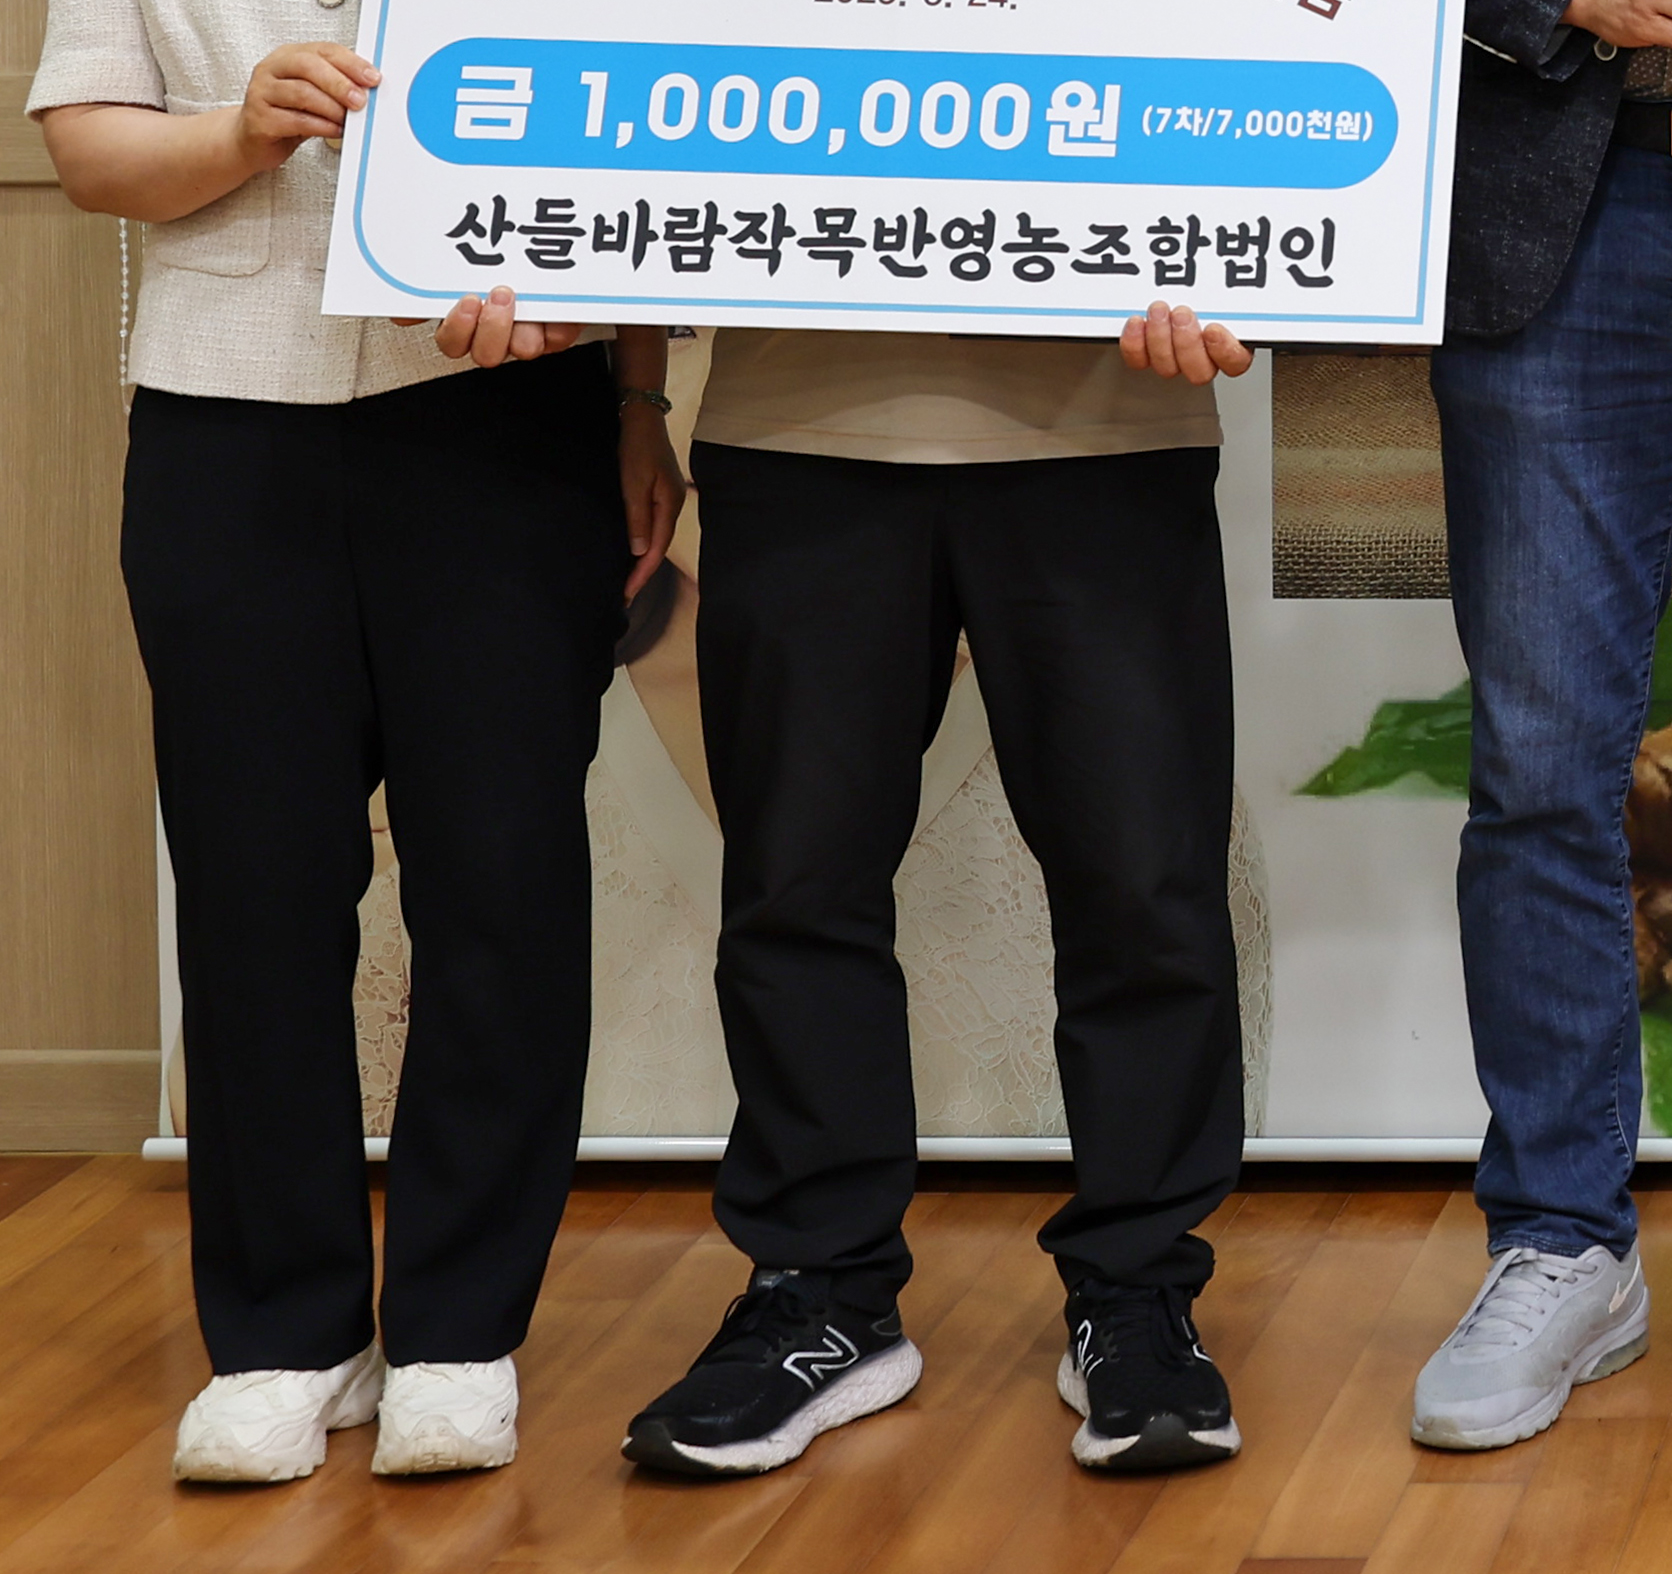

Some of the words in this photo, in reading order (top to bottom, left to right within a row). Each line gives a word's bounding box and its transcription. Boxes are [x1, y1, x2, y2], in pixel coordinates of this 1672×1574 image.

[453, 65, 534, 141] 금
[580, 71, 1122, 158] 1,000,000원
[1142, 105, 1373, 142] (7차/7,000천원)
[445, 194, 1336, 289] 산들바람작목반영농조합법인
